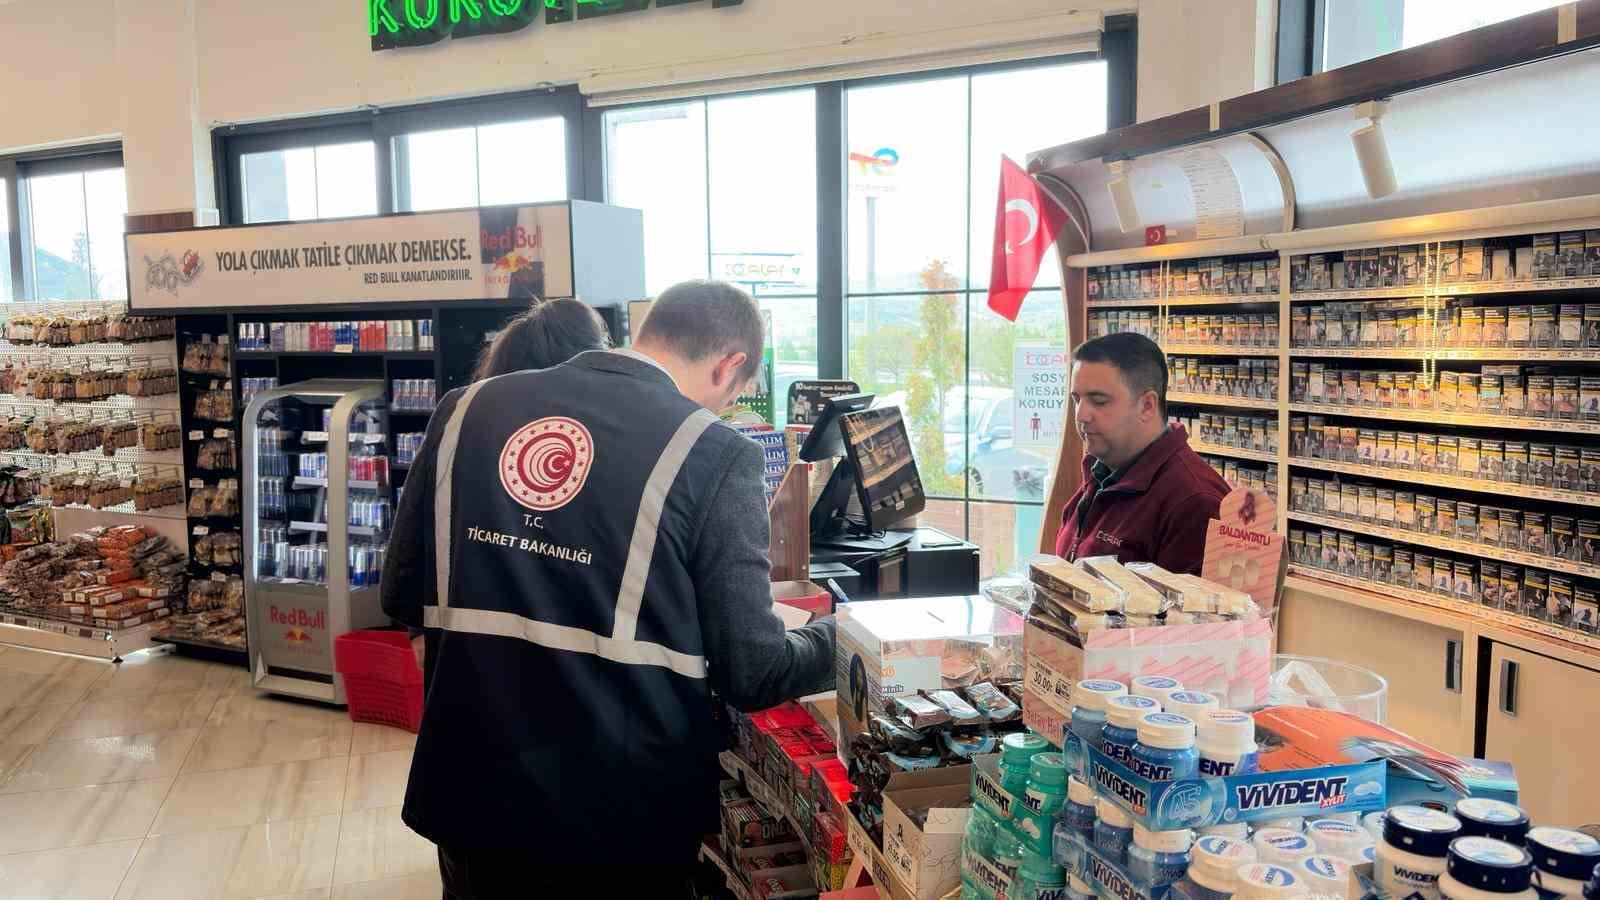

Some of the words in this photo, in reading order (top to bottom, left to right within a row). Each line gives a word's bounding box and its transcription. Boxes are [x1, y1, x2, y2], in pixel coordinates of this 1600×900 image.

[480, 228, 513, 250] Red
[516, 224, 543, 249] Bull
[216, 250, 248, 272] YOLA
[249, 248, 300, 275] ÇIKMAK
[302, 240, 341, 267] TATİLE
[344, 242, 397, 271] ÇIKMAK
[401, 238, 471, 263] DEMEKSE.
[364, 272, 379, 284] RED
[380, 271, 400, 284] BULL
[523, 513, 544, 529] T.C.
[467, 525, 518, 548] TİCARET
[520, 538, 592, 565] BAKANLIĞI
[271, 605, 297, 625] Red
[299, 608, 326, 630] Bull
